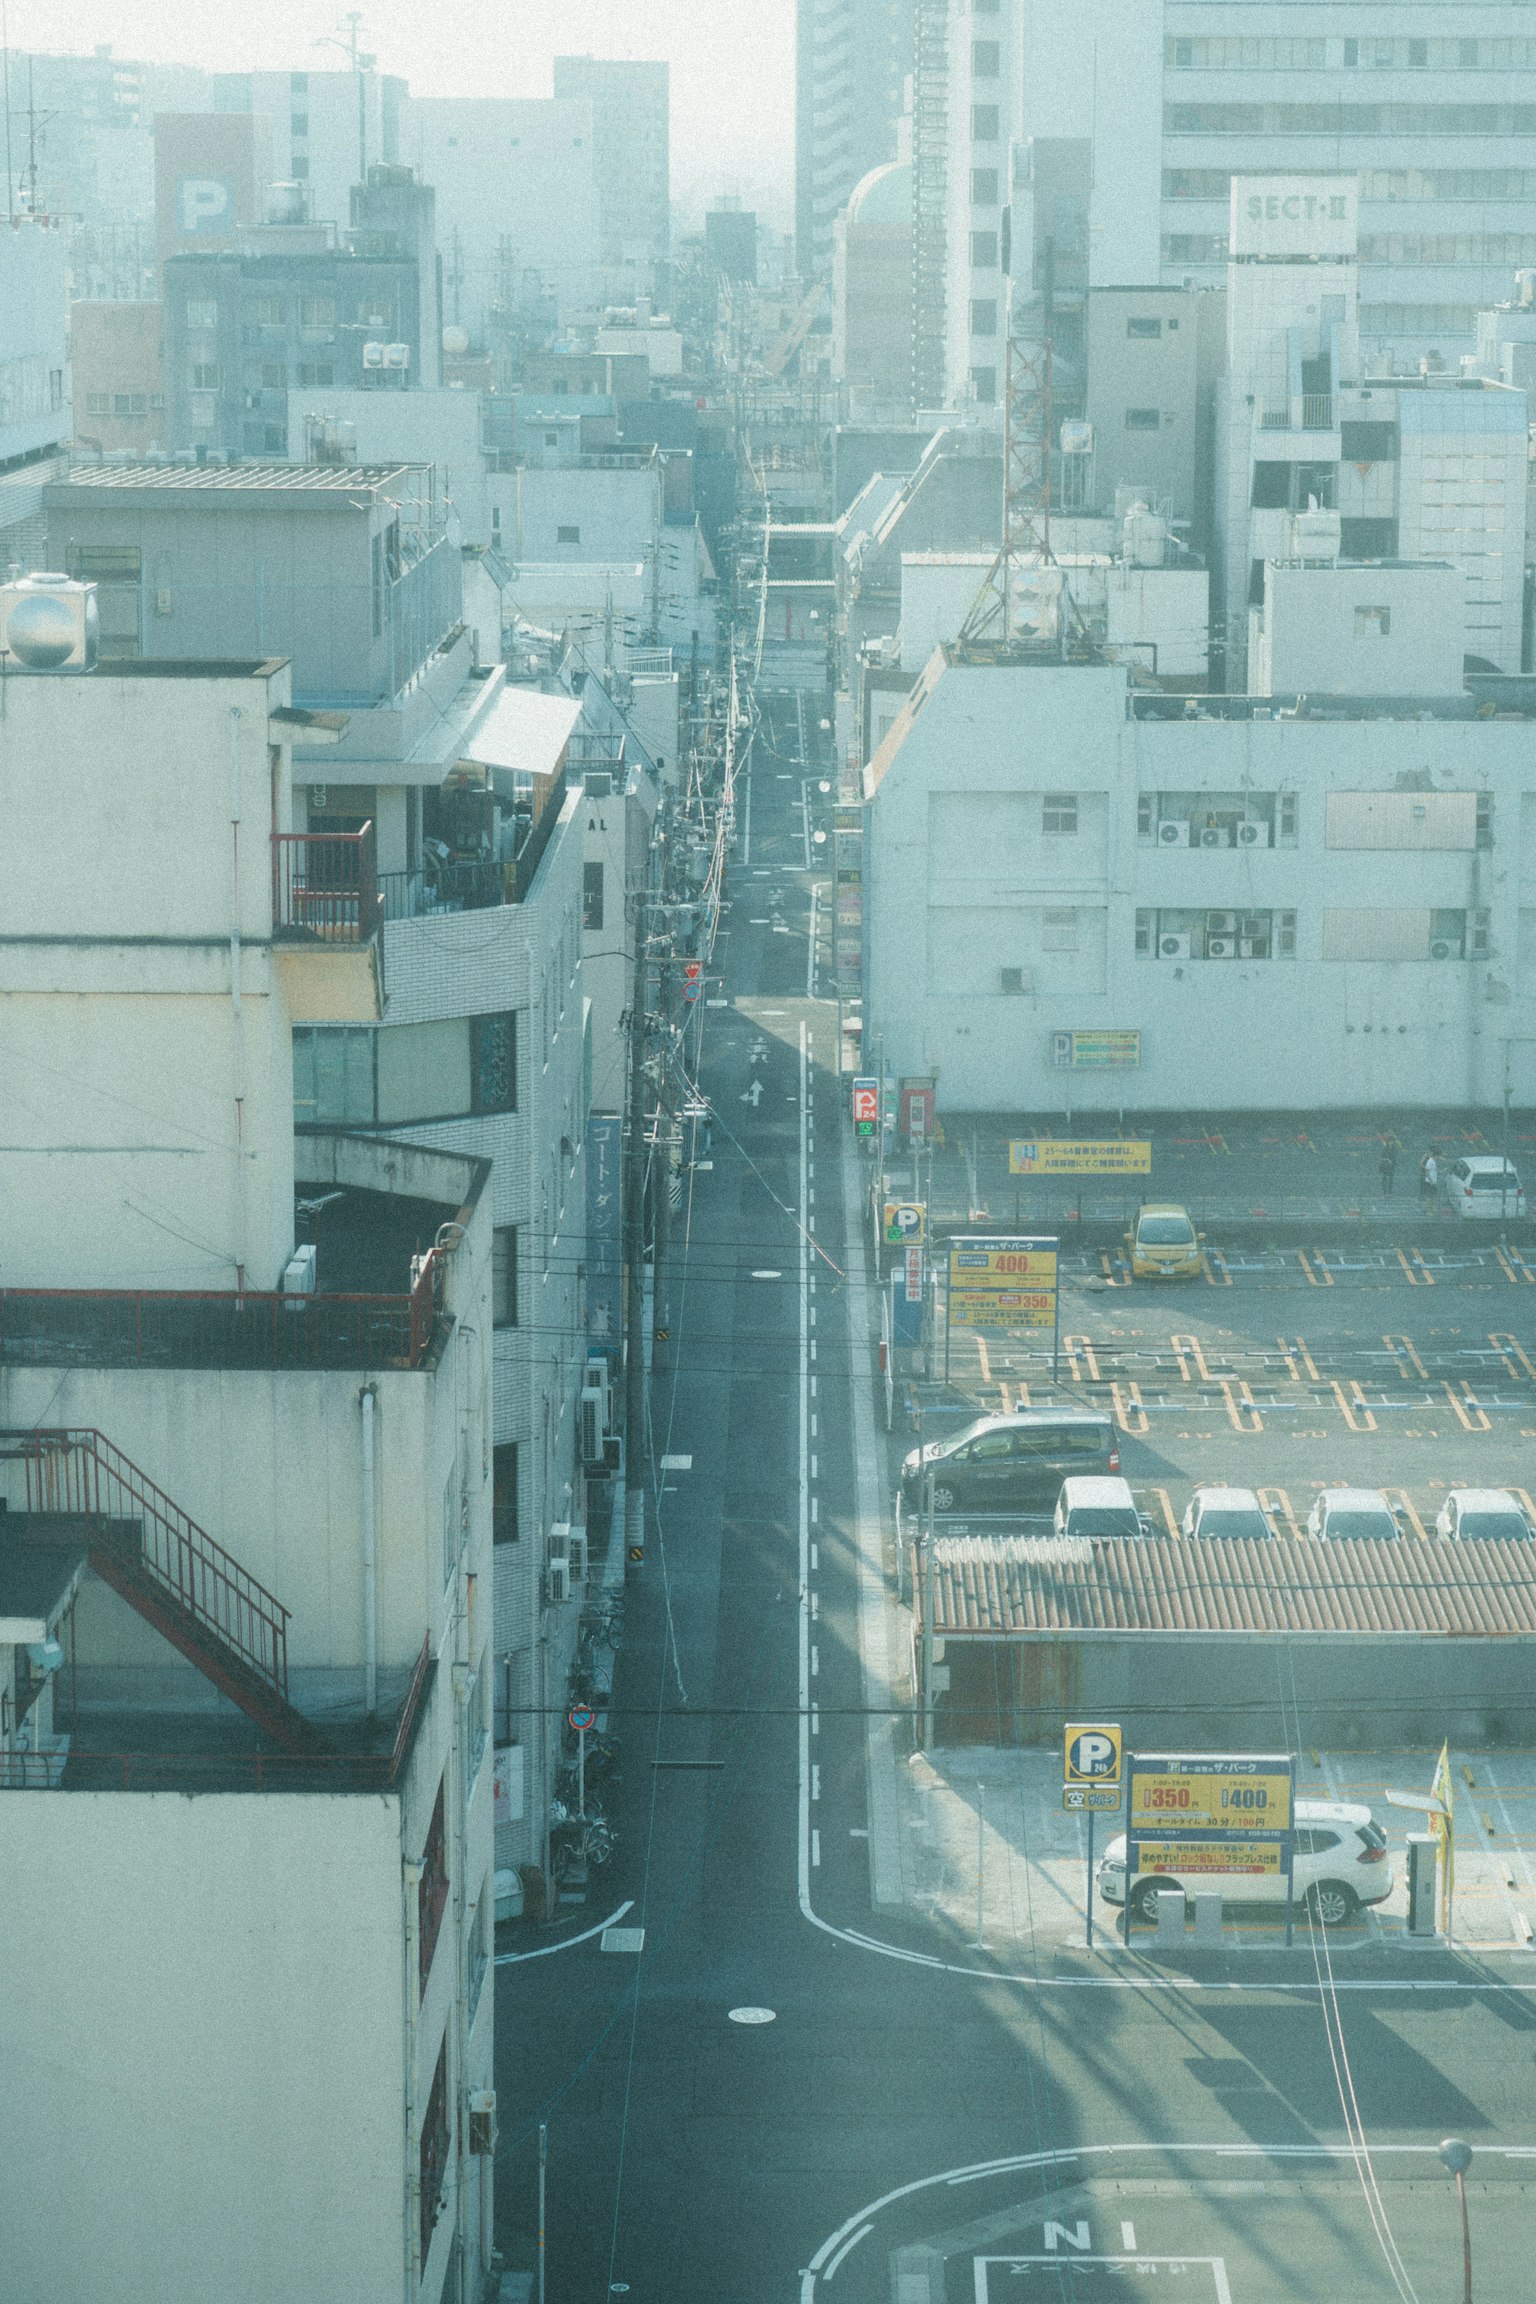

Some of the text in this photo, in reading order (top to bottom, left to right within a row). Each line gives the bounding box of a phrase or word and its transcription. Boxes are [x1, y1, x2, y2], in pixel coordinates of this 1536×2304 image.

[182, 180, 228, 230] P
[897, 1208, 918, 1233] P
[995, 1254, 1029, 1273] 400
[1023, 1295, 1049, 1309] 350
[1078, 1735, 1113, 1773] P
[1094, 1762, 1109, 1773] 24h
[1068, 1790, 1085, 1808] 空
[1155, 1817, 1201, 1826] オールタイム
